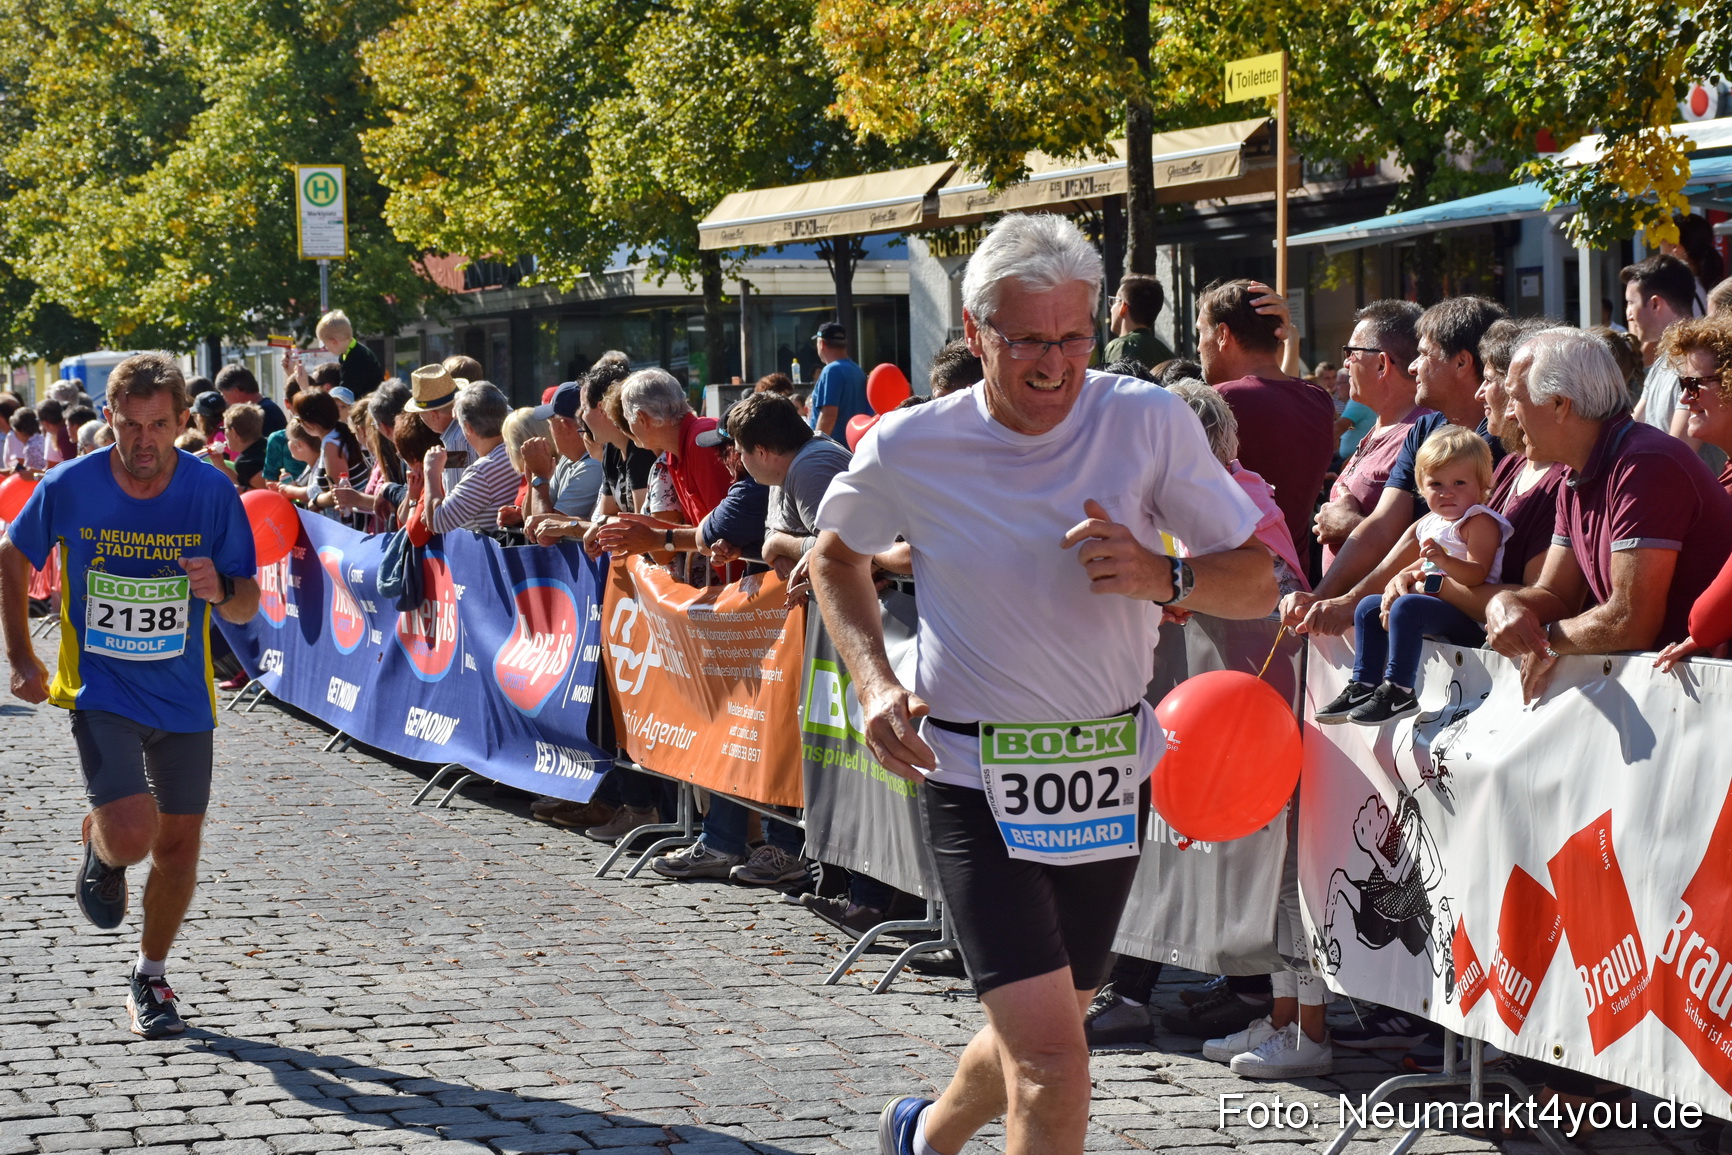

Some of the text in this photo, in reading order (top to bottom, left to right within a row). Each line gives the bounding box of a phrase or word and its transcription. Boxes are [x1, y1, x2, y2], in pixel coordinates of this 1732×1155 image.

[1236, 69, 1279, 89] Toiletten
[313, 180, 329, 199] H
[79, 527, 201, 547] 10. NEUMARKTER
[95, 542, 182, 561] STADTLAUF
[96, 577, 179, 599] BOCK
[97, 603, 177, 633] 2138
[755, 607, 788, 619] Partner
[105, 635, 166, 652] RUDOLF
[705, 627, 744, 643] Konzeption
[745, 626, 761, 639] und
[501, 614, 572, 686] hervis
[716, 646, 752, 662] Projekte
[638, 712, 697, 751] Agentur
[995, 724, 1121, 756] BOCK
[534, 740, 556, 774] GET
[1125, 767, 1133, 776] D
[1001, 766, 1120, 816] 3002
[1010, 822, 1124, 848] BERNHARD
[1656, 898, 1732, 1021] Brau
[1576, 933, 1642, 1016] Braun
[1611, 993, 1631, 1015] Sicher
[1628, 987, 1638, 1001] ist
[1684, 998, 1708, 1033] Sicher
[1707, 1024, 1723, 1046] ist
